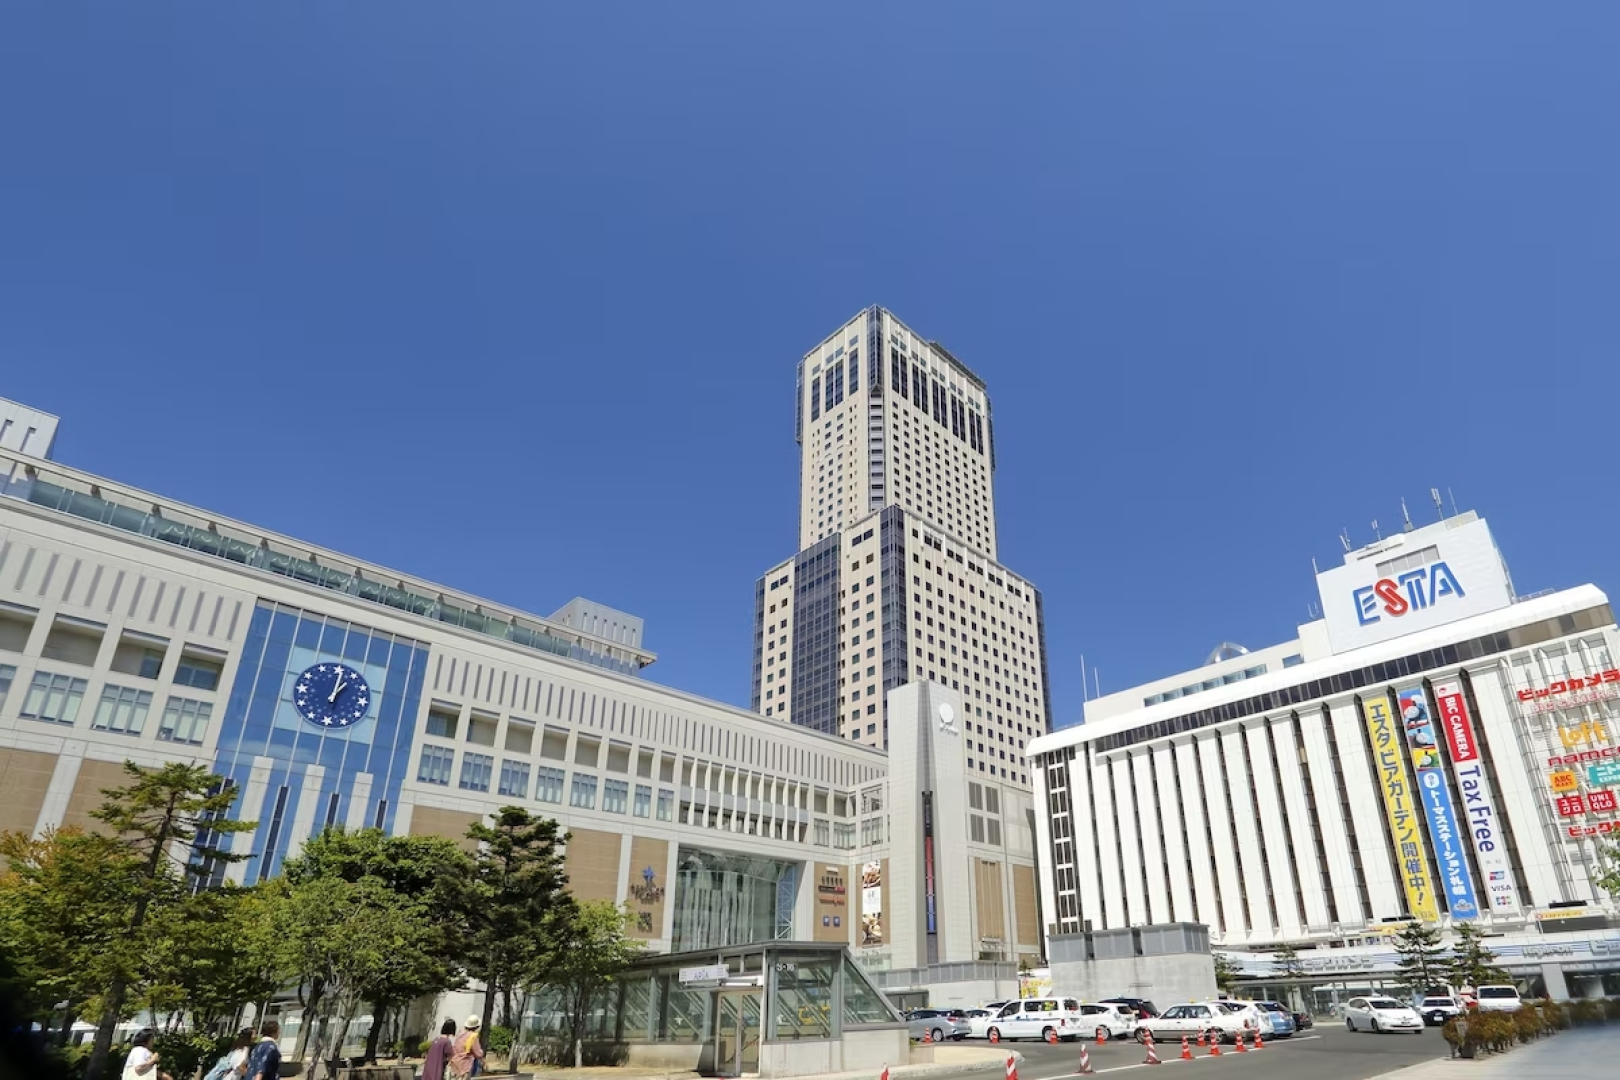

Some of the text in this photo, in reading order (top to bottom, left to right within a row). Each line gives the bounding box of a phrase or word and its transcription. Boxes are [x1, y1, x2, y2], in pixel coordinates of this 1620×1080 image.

[1352, 561, 1465, 626] ESTA
[1517, 669, 1620, 701] ビックカメラ
[1558, 689, 1617, 708] CAMERA
[1444, 696, 1471, 760] BIC CAMERA
[1460, 764, 1482, 803] Tax
[1554, 774, 1571, 783] ABC
[1561, 796, 1580, 807] ユニ
[1590, 793, 1609, 803] UNI
[1562, 805, 1582, 815] クロ
[1592, 801, 1612, 811] QLO
[1469, 805, 1495, 853] Free
[1491, 884, 1512, 892] VISA
